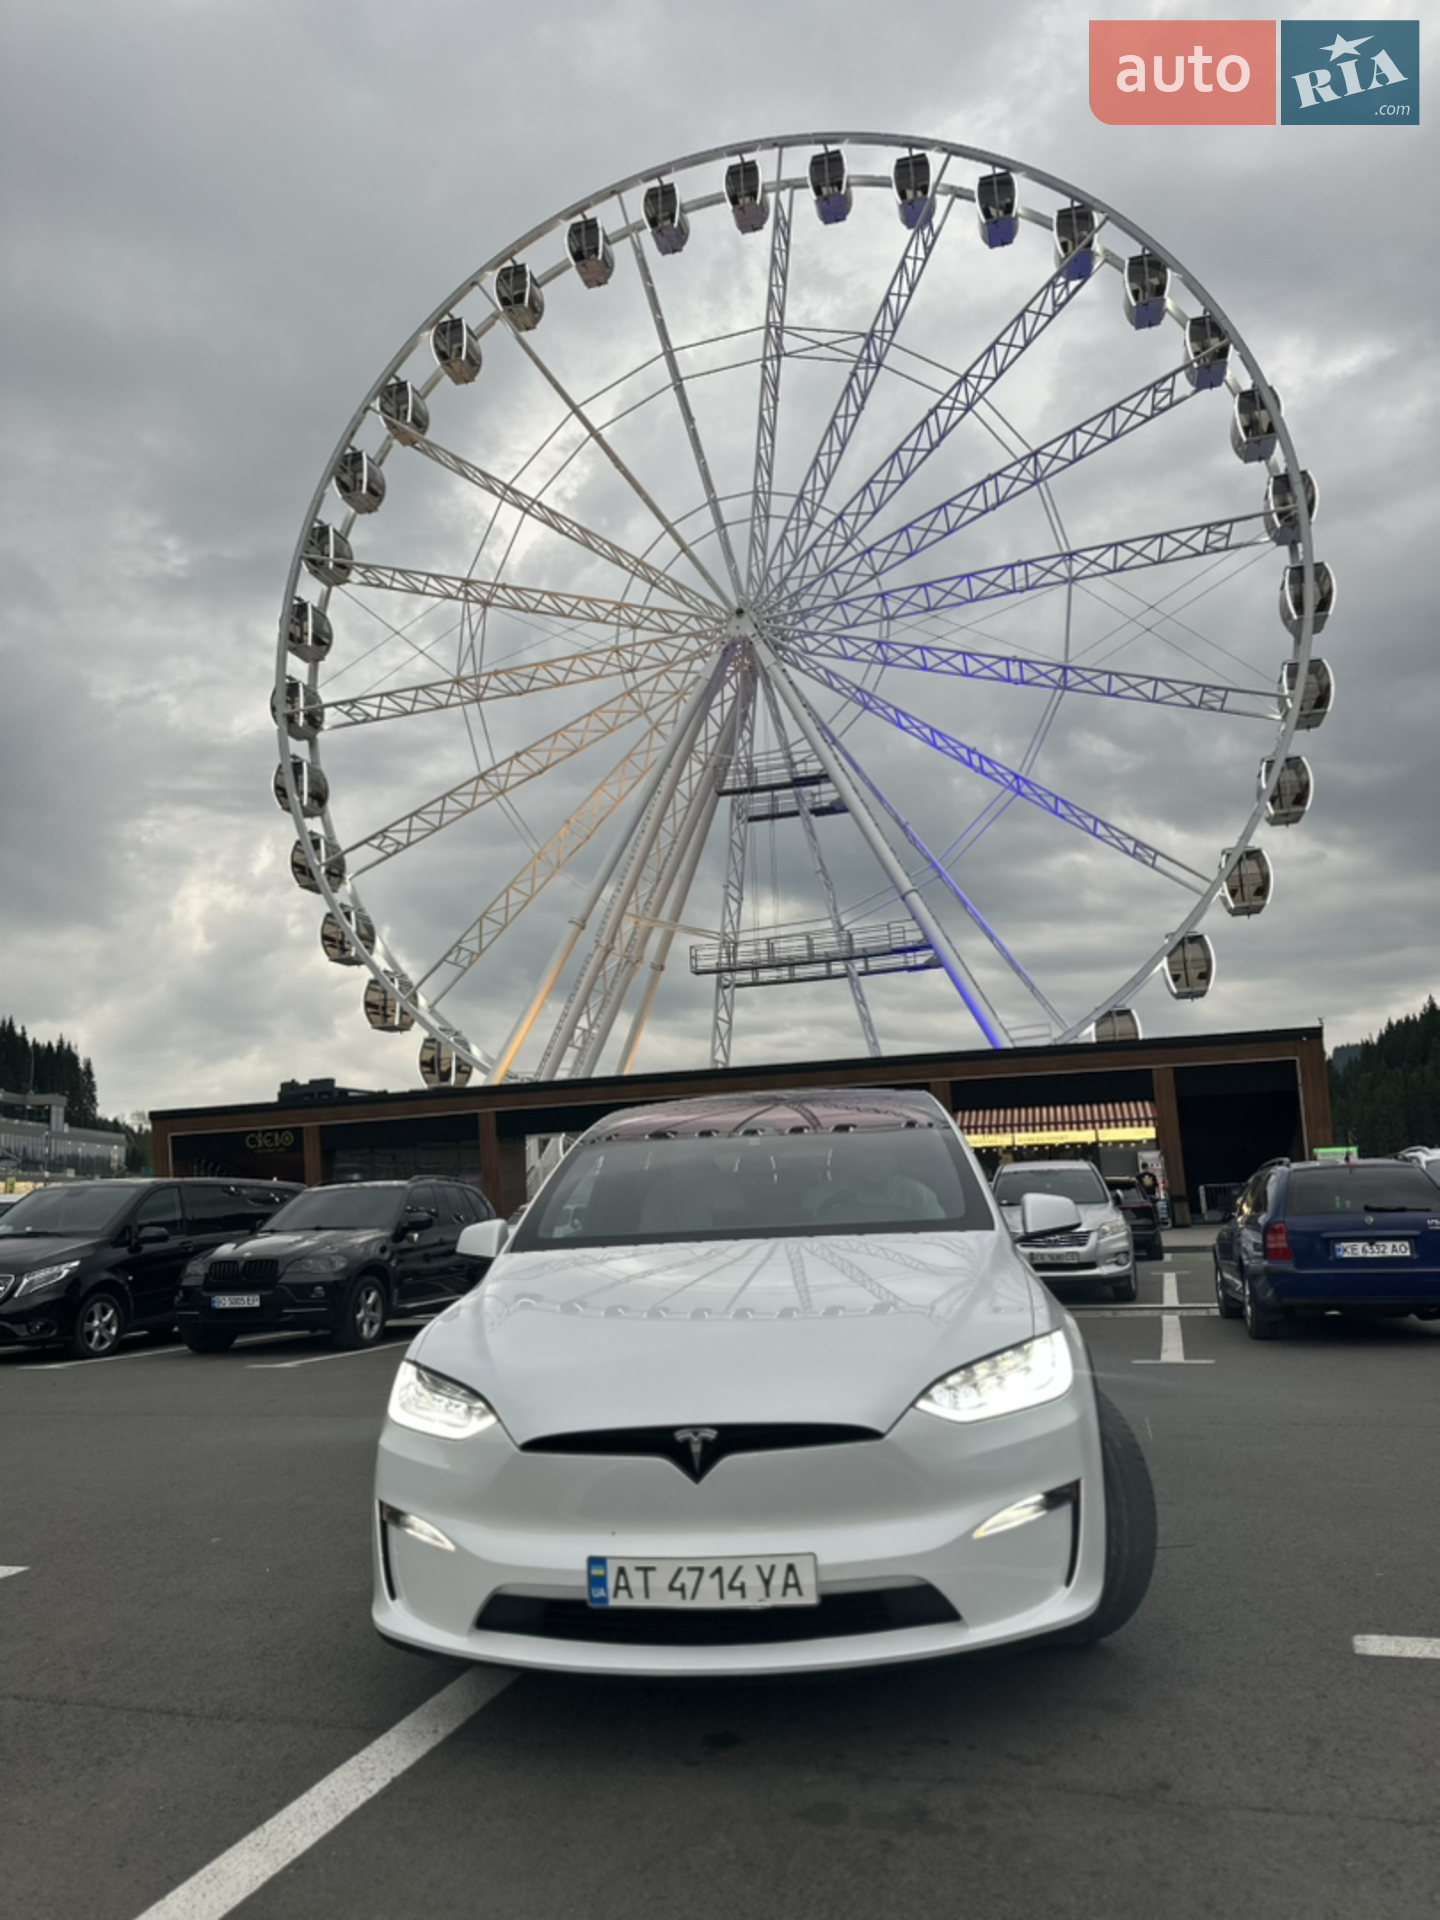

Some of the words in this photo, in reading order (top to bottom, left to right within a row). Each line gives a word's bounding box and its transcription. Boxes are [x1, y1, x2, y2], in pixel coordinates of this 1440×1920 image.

[612, 1565, 657, 1600] AT
[667, 1564, 747, 1601] 4714
[755, 1562, 804, 1598] YA
